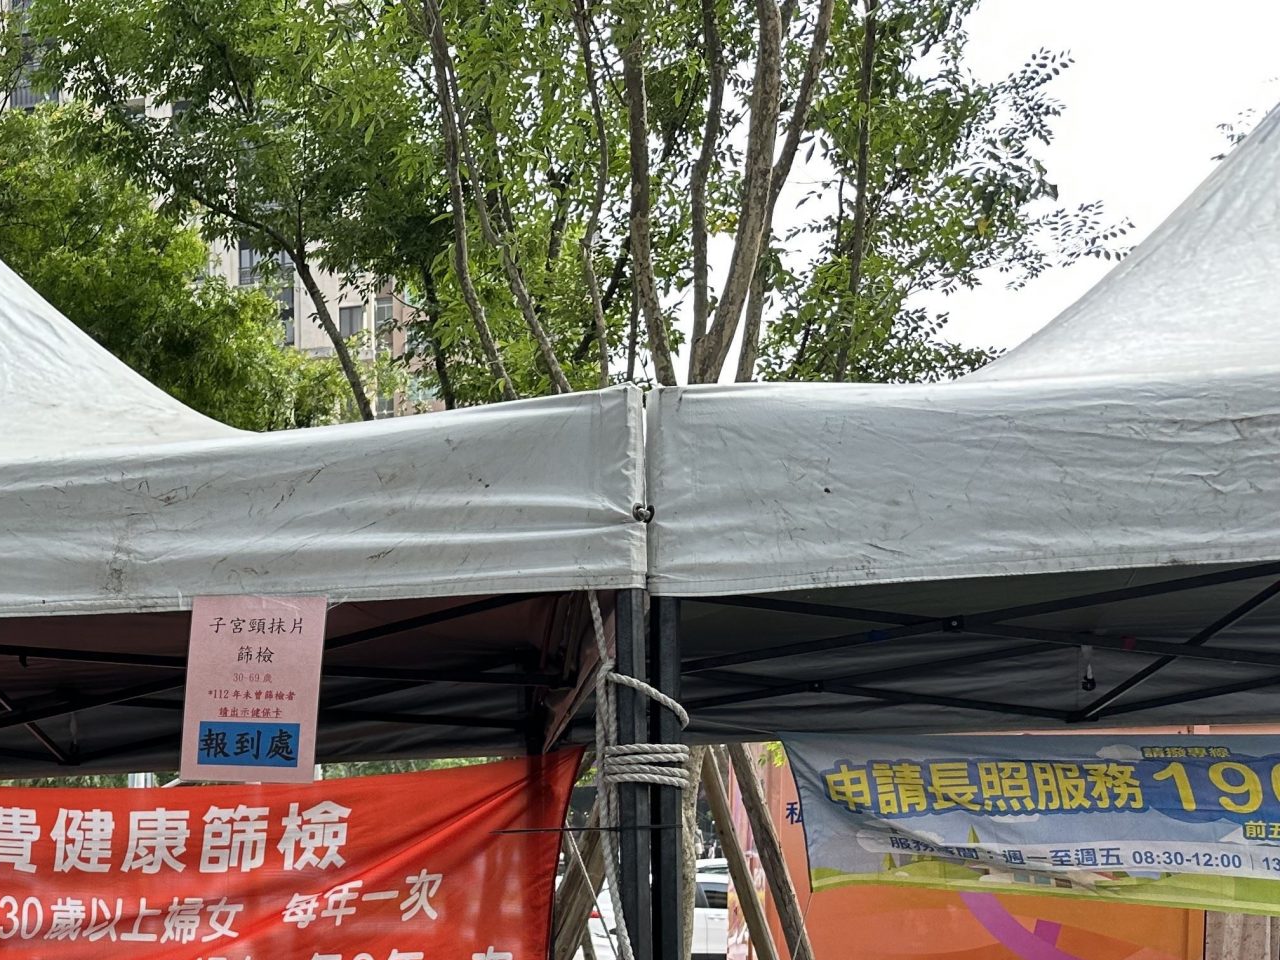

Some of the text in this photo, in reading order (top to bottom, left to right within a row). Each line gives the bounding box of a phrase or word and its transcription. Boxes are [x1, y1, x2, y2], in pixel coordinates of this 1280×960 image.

[209, 617, 304, 635] 子宮頸抹片
[237, 646, 275, 664] 篩檢
[218, 707, 283, 719] 請出示健保卡
[199, 728, 297, 762] 報到處
[824, 760, 1280, 815] 申請長照服務 19
[1132, 850, 1242, 869] 08:30-12:00
[281, 868, 444, 930] 每年一次
